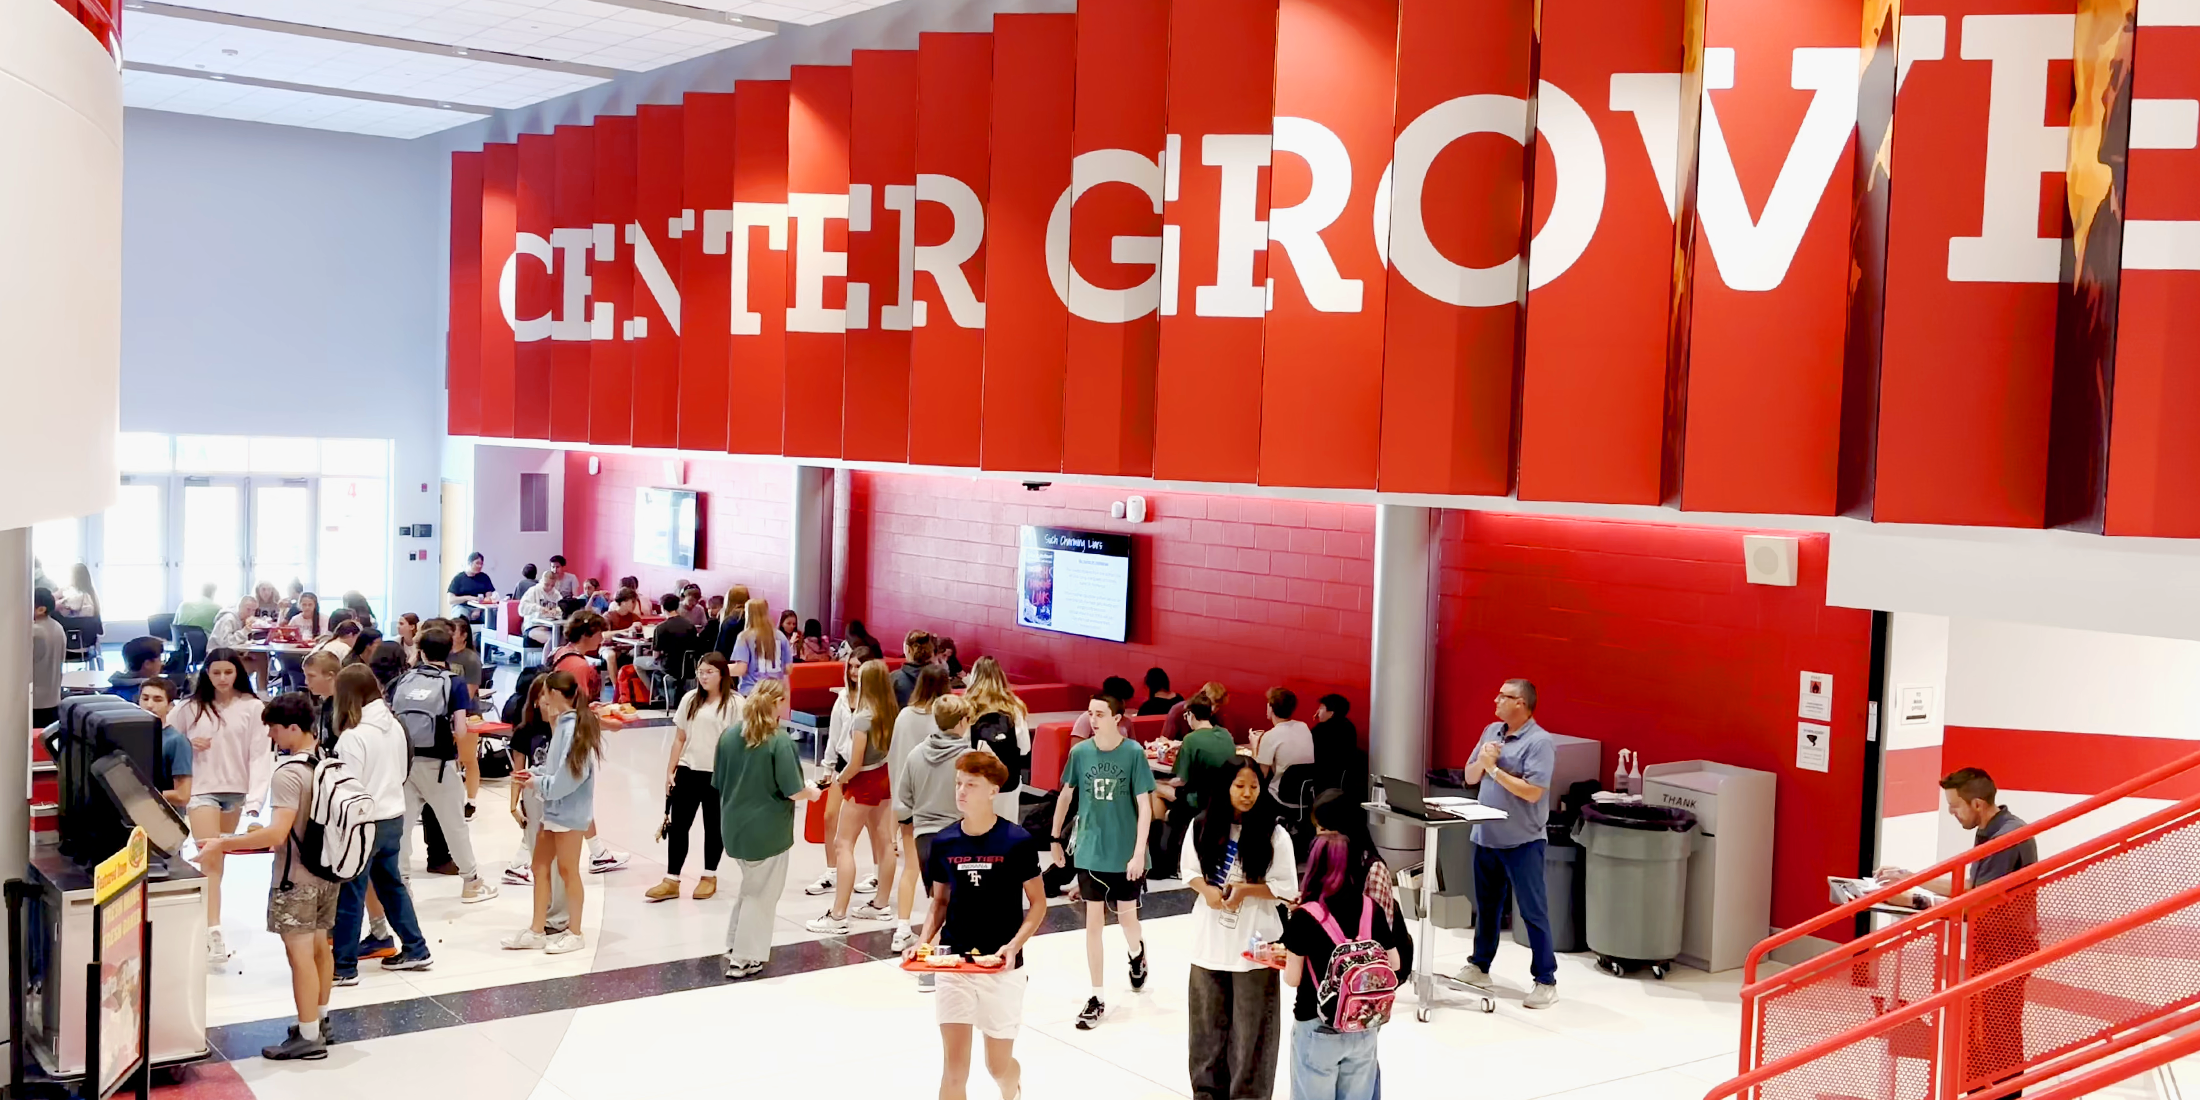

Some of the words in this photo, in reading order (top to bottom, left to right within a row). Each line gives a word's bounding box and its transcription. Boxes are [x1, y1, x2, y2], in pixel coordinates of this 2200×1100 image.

[498, 173, 985, 343] CENTER
[1045, 0, 2200, 323] GROVE
[1093, 778, 1118, 801] 87
[1662, 793, 1697, 809] THANK
[947, 856, 972, 864] TOP
[975, 856, 1005, 864] TIER
